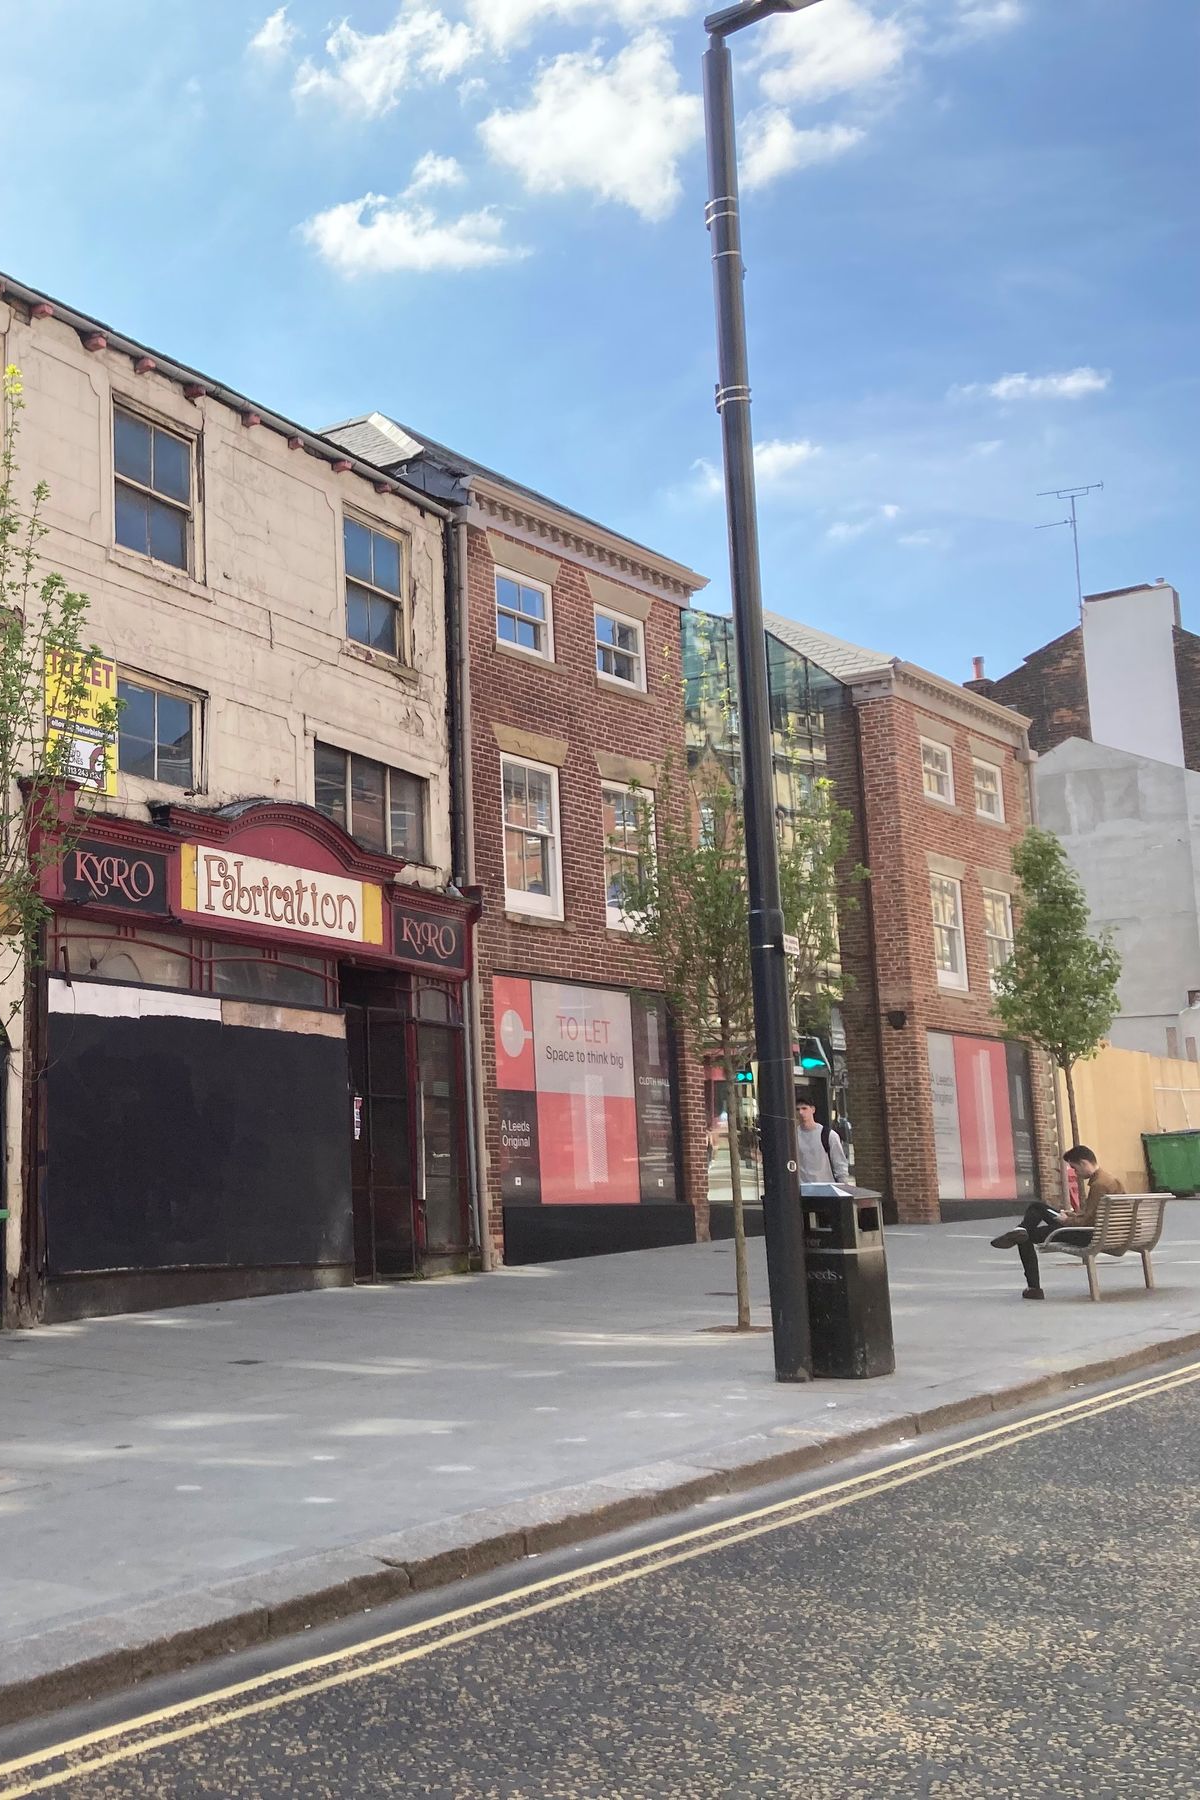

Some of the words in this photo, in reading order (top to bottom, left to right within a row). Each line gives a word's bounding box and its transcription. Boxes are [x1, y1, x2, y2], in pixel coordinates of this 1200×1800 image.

[50, 650, 75, 678] TO
[80, 657, 114, 689] LET
[65, 684, 92, 702] Rail
[202, 854, 357, 934] Fabrication
[556, 1015, 579, 1041] TO
[584, 1019, 611, 1044] LET
[546, 1045, 574, 1062] Space
[576, 1050, 586, 1063] to
[587, 1050, 608, 1065] think
[610, 1052, 624, 1069] big
[501, 1119, 508, 1131] A
[508, 1119, 531, 1132] Leeds
[502, 1135, 531, 1149] Original
[807, 1268, 838, 1280] eeds
